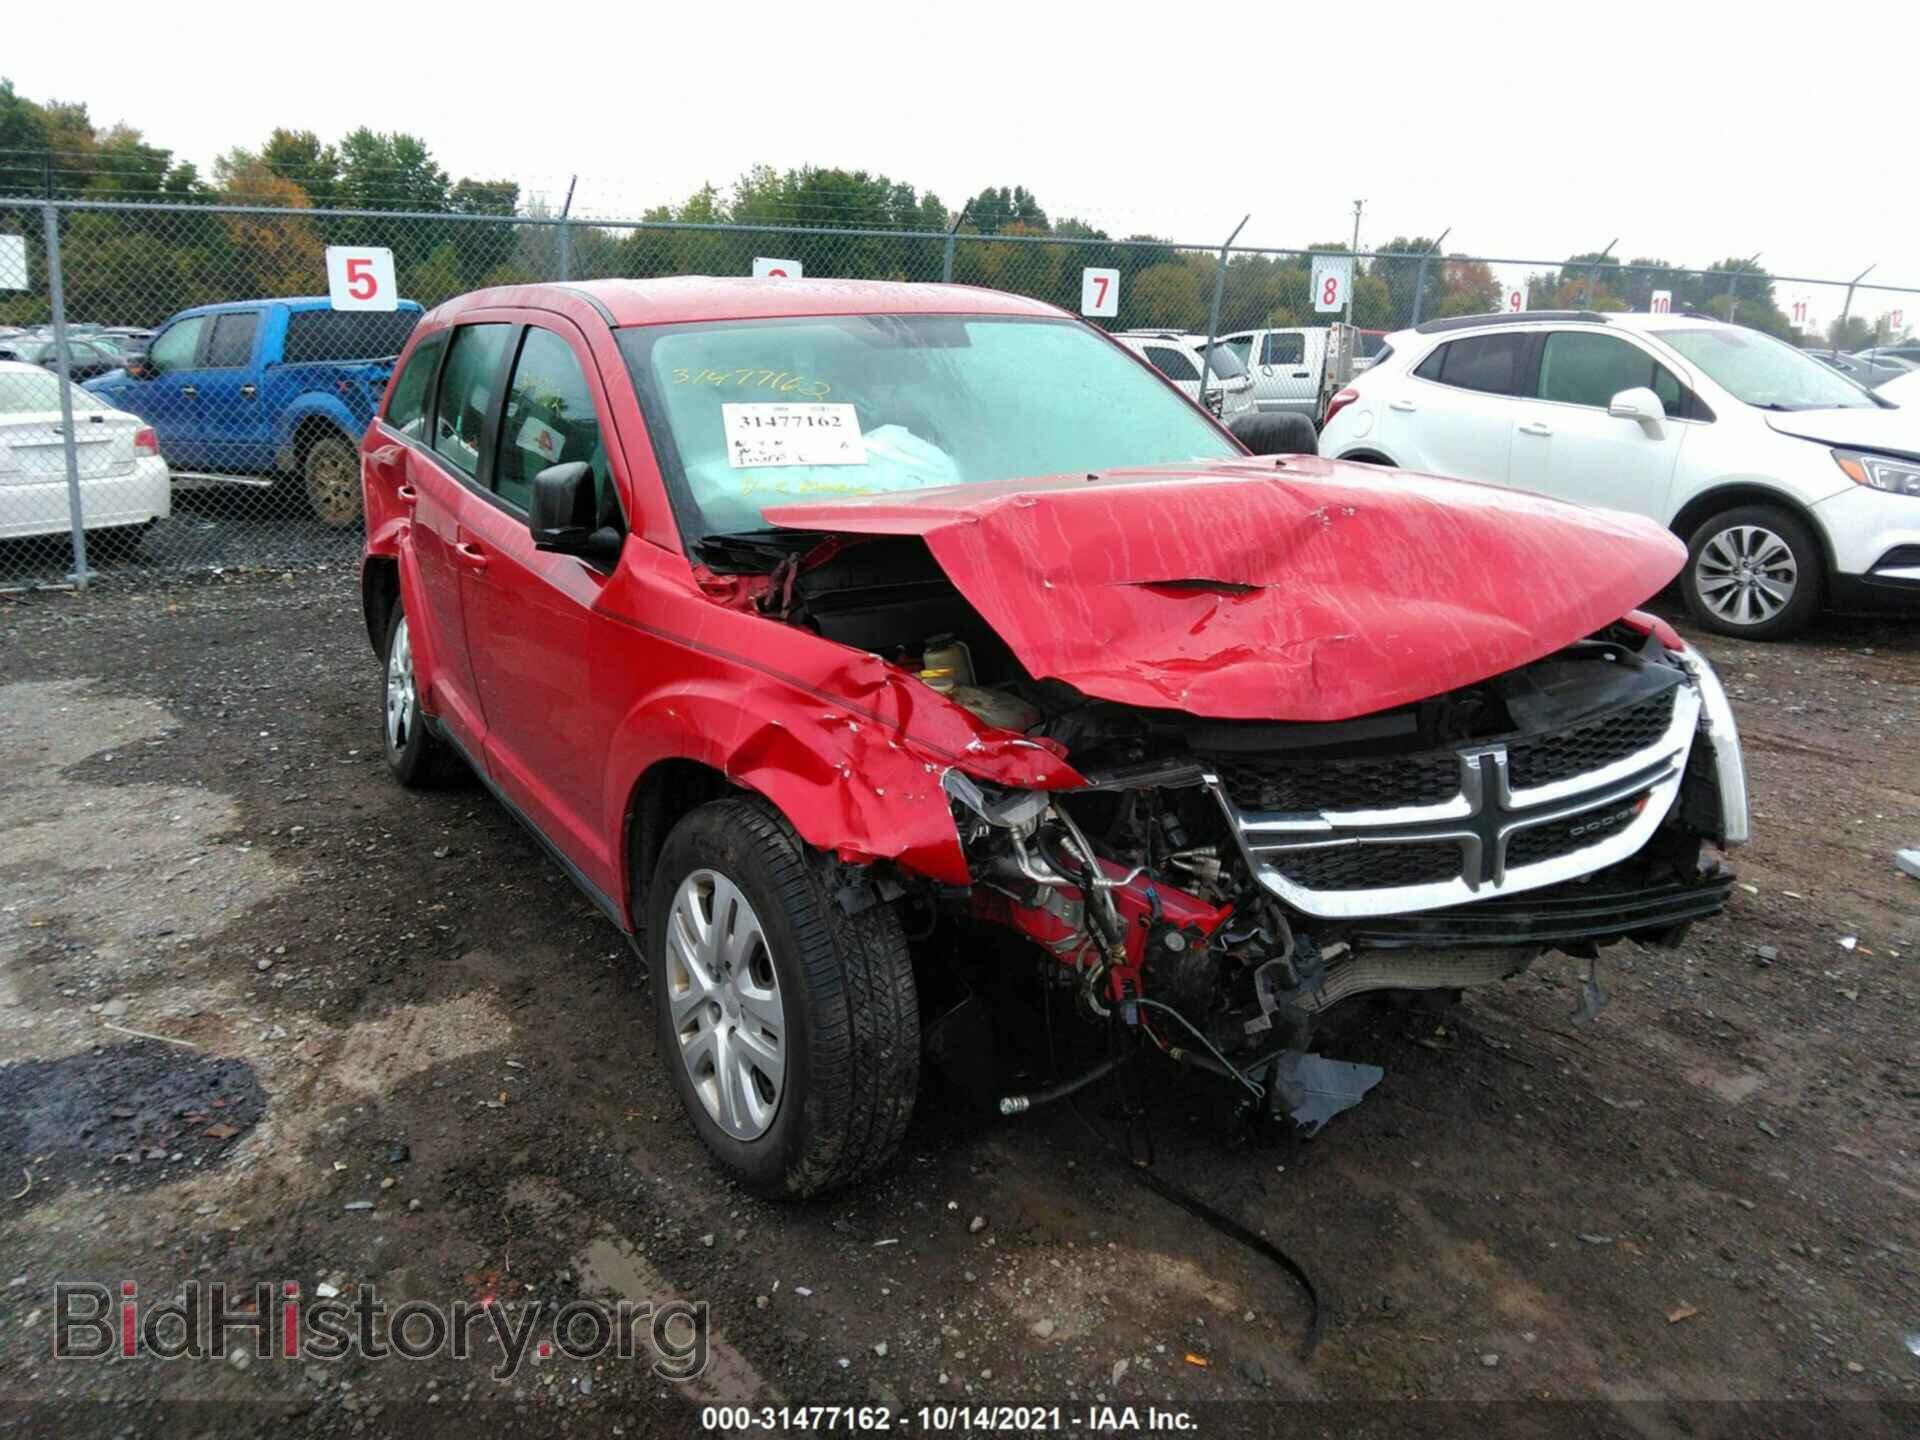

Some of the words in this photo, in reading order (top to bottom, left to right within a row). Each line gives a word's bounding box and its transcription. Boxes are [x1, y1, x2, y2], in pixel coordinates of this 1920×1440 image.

[346, 258, 378, 300] 5
[1093, 277, 1108, 308] 7
[1323, 278, 1337, 305] 8
[1510, 291, 1521, 313] 9
[1652, 297, 1669, 314] 10
[1792, 302, 1807, 322] 11
[738, 415, 842, 429] 31477162
